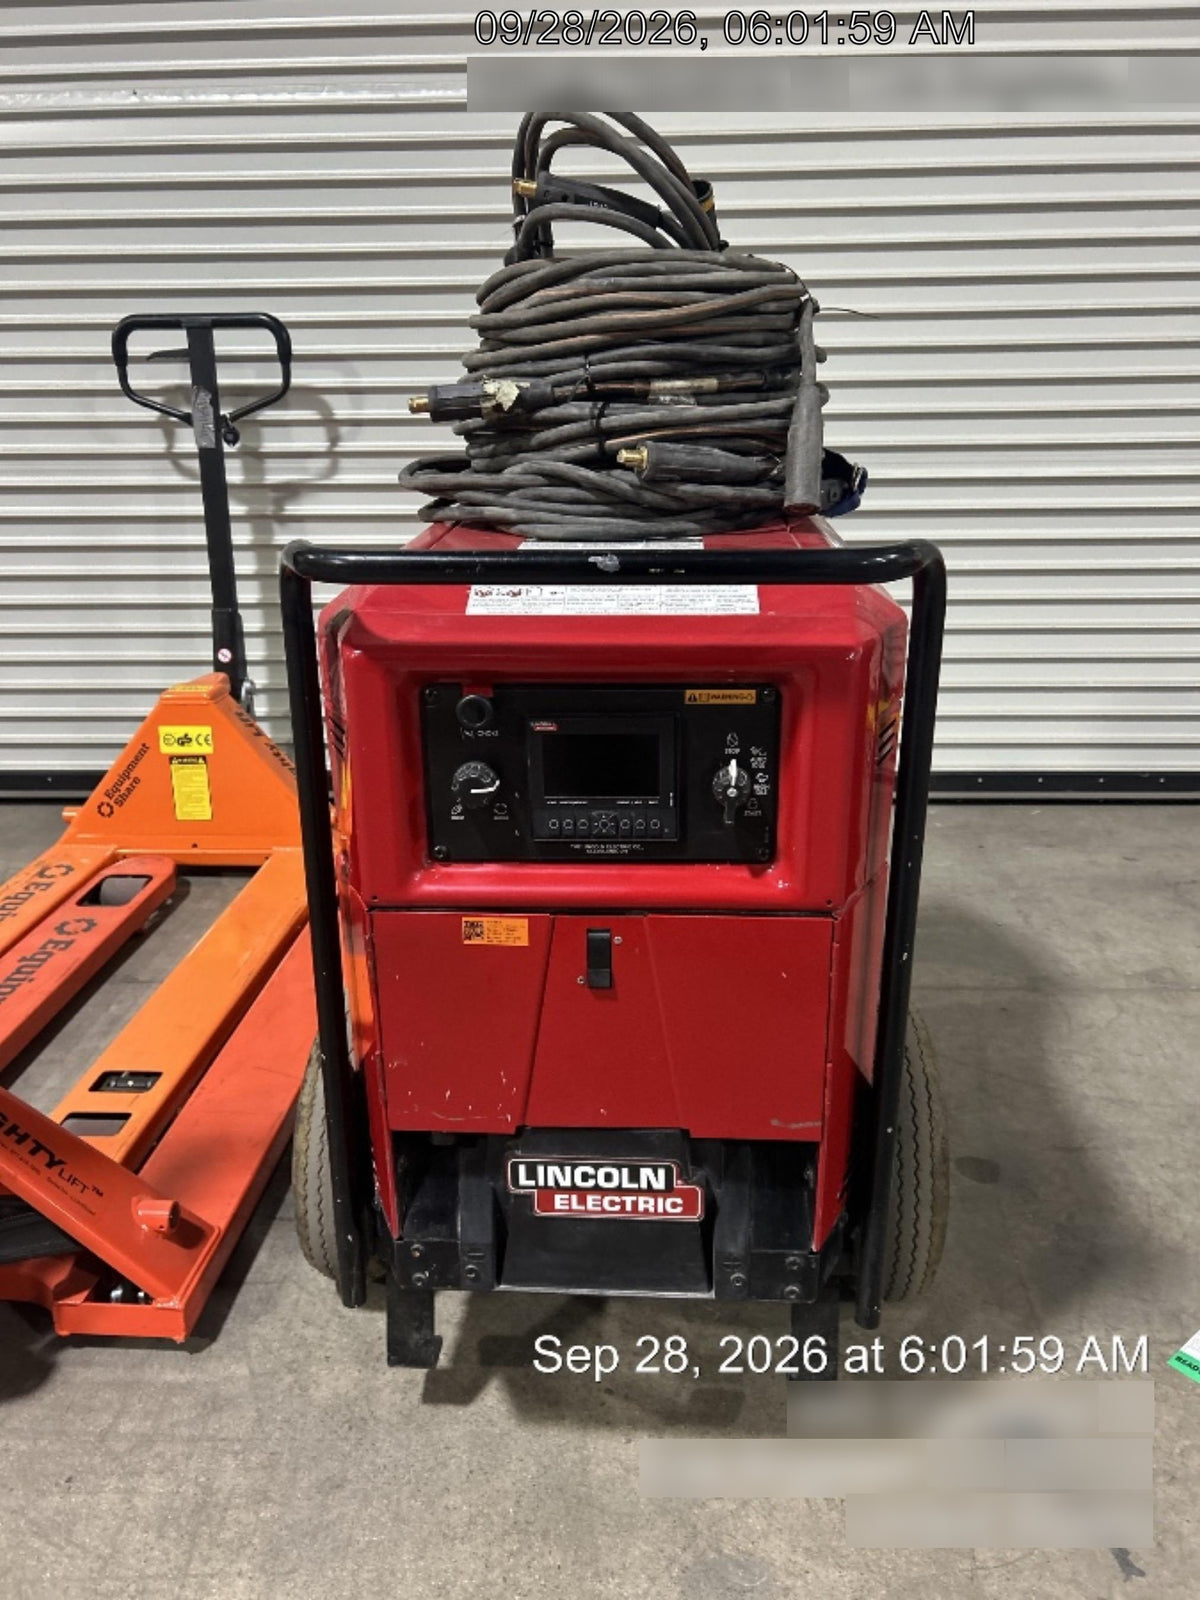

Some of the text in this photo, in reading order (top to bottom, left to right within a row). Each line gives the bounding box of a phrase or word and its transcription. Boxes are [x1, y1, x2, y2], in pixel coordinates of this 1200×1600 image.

[104, 743, 150, 800] Equipment
[113, 776, 141, 808] Share
[0, 880, 54, 922] Equi
[0, 938, 75, 1005] Equip
[518, 1163, 666, 1190] LINCOLN
[554, 1194, 684, 1213] ELECTRIC
[1175, 1356, 1200, 1376] READ
